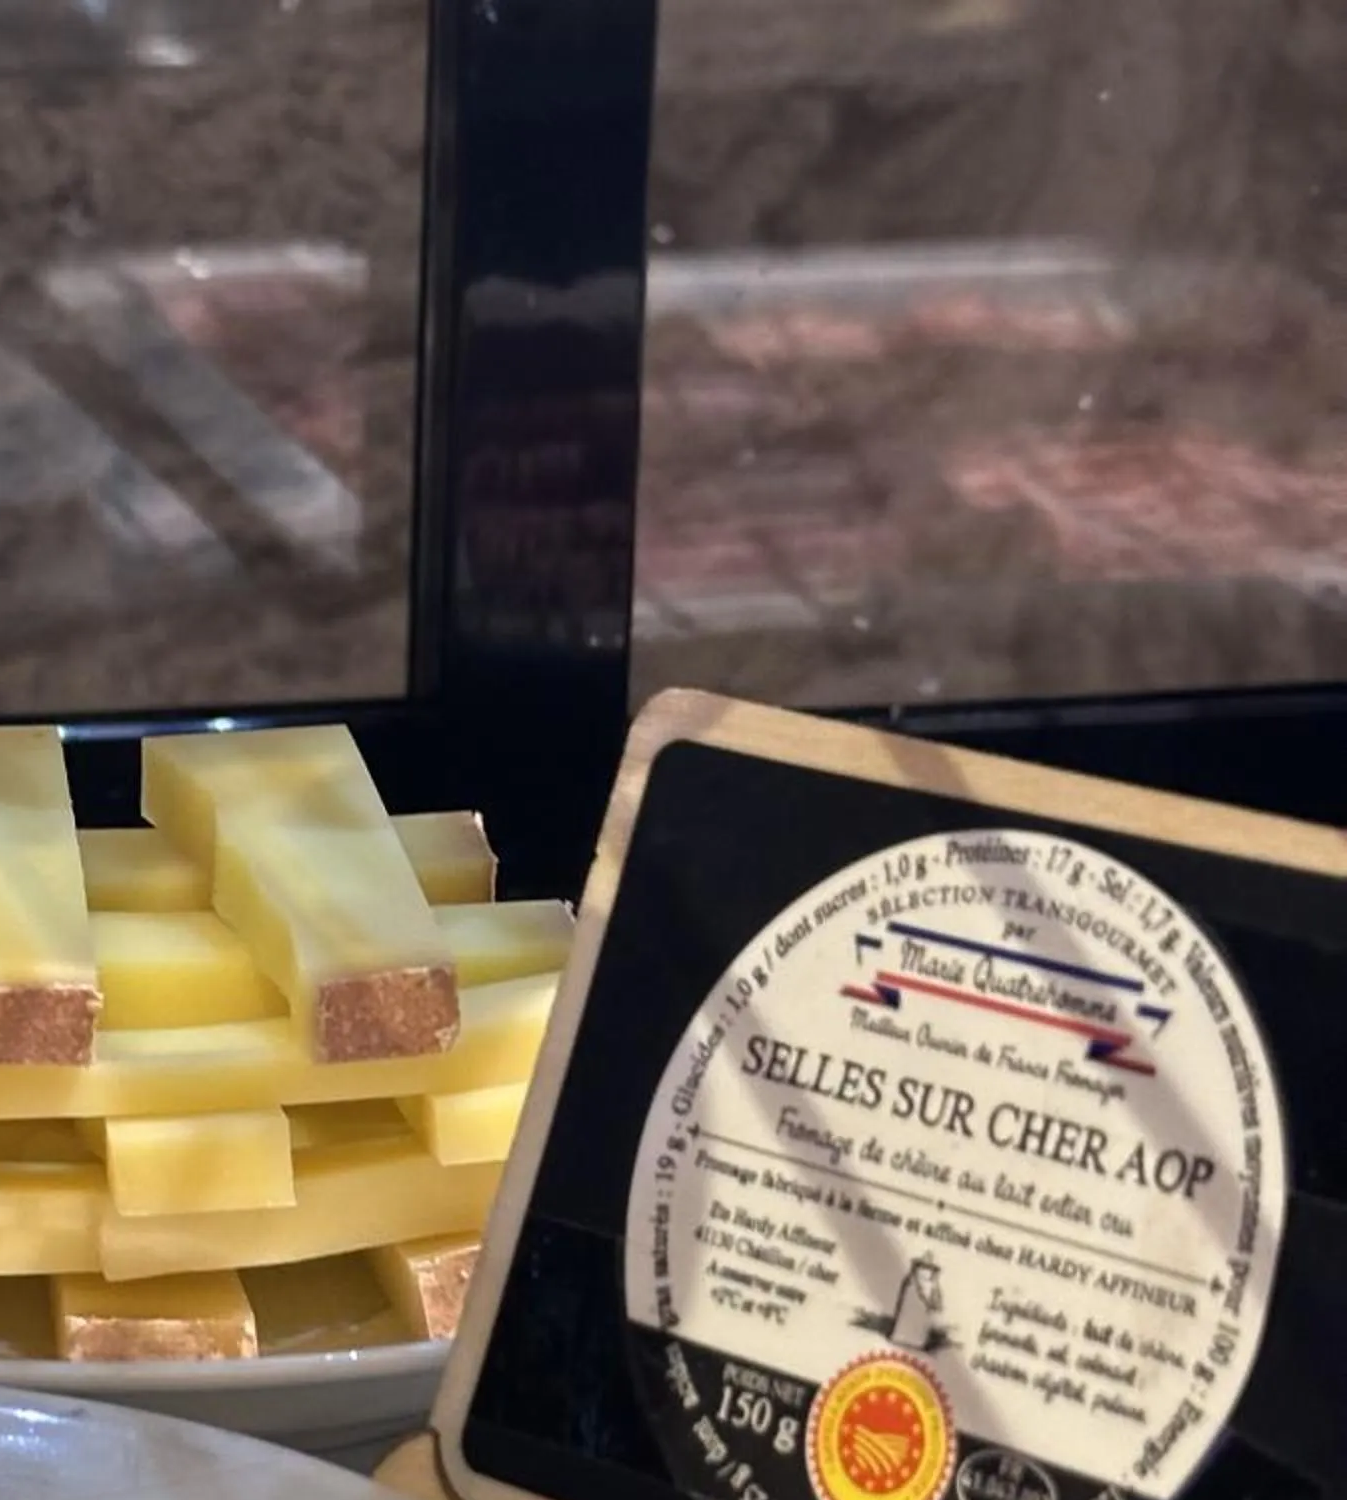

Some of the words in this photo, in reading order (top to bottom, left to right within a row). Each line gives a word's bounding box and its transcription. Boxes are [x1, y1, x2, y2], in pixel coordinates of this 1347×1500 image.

[774, 917, 813, 959] dont
[671, 1024, 727, 1117] Glucides
[741, 1034, 888, 1111] SELLES
[890, 1076, 975, 1139] SUR
[987, 1101, 1108, 1176] CHER
[1114, 1140, 1216, 1200] AOP
[1017, 1246, 1093, 1285] HARDY
[1093, 1273, 1197, 1318] AFFINEUR
[1224, 1256, 1251, 1319] pour
[1208, 1320, 1240, 1367] 100
[716, 1385, 773, 1435] 150
[773, 1416, 799, 1455] g
